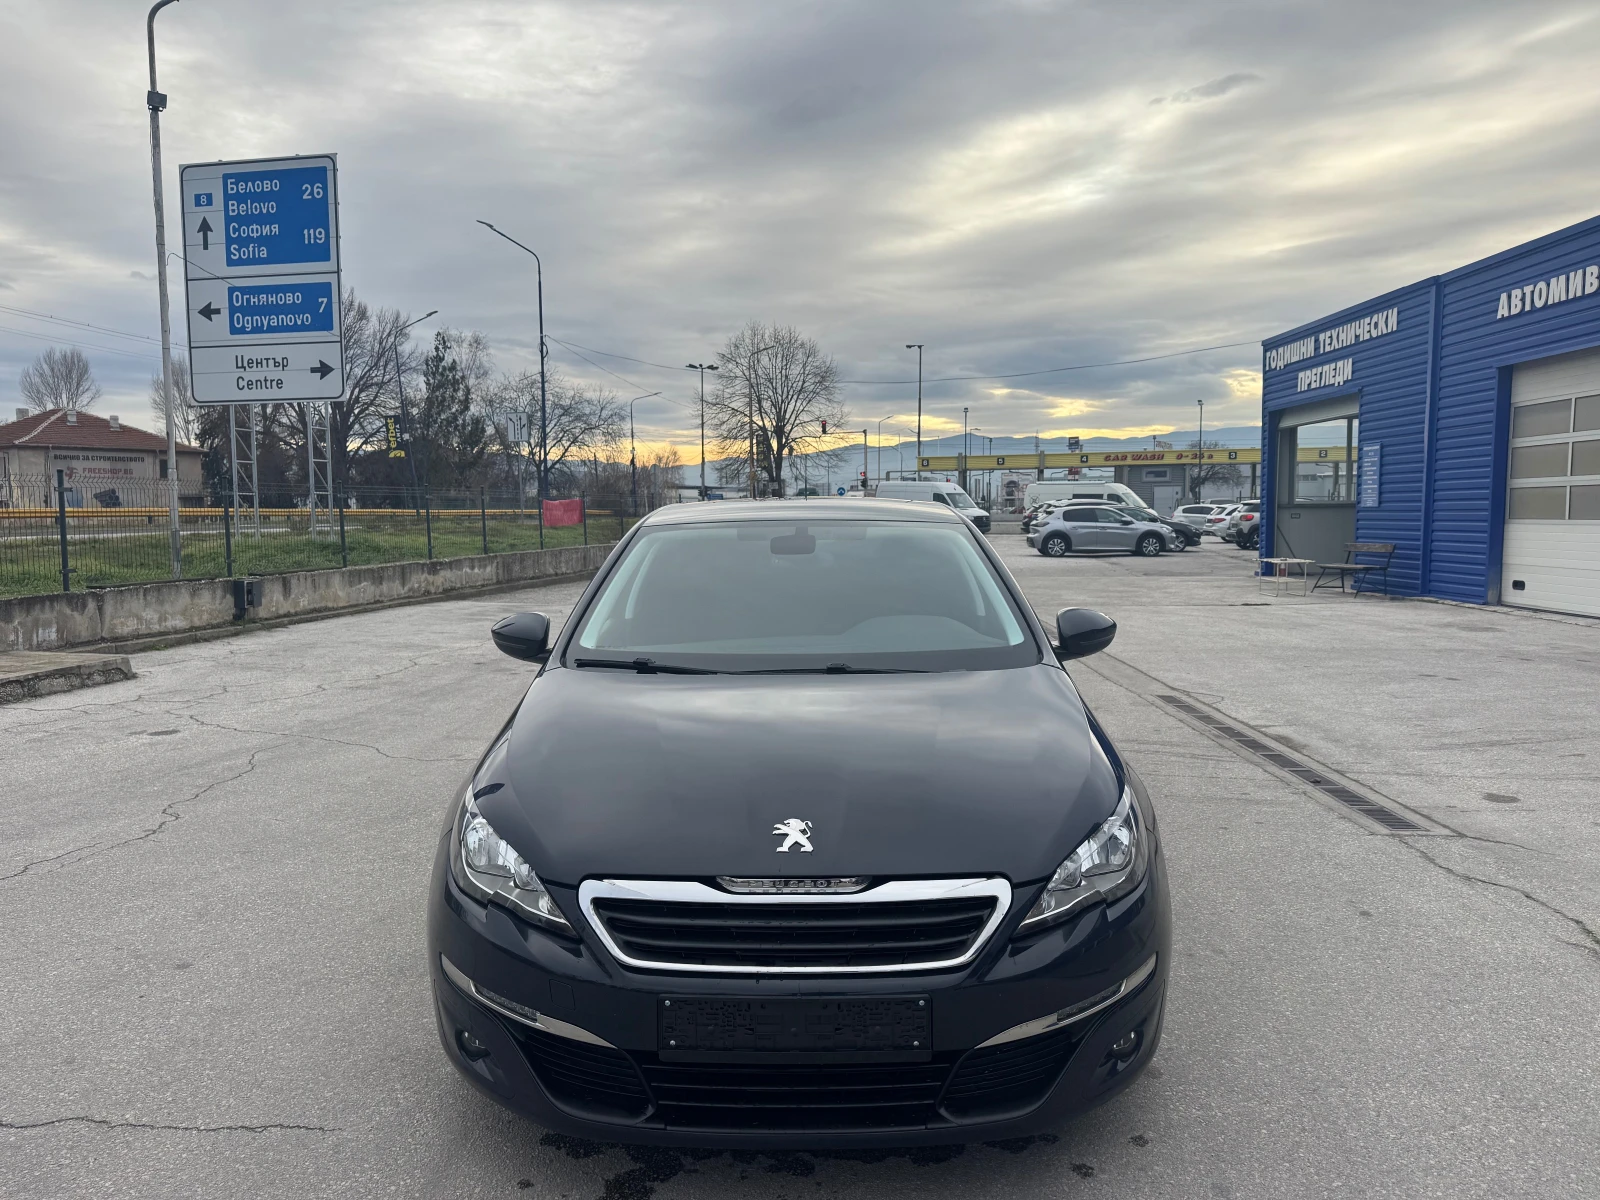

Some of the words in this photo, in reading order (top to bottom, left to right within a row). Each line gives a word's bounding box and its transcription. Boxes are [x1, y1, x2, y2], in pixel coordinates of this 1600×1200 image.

[227, 179, 280, 194] Белово
[302, 183, 323, 199] 26
[200, 195, 207, 205] 8
[228, 200, 277, 216] Belovo
[229, 222, 279, 238] София
[303, 228, 325, 244] 119
[230, 244, 267, 260] Sofia
[232, 291, 302, 306] Огняново
[1497, 265, 1600, 320] АВТОМИВ
[318, 298, 328, 313] 7
[233, 312, 311, 331] Ognyanovo
[1265, 336, 1315, 371] ГОДИШНИ
[1319, 307, 1398, 354] ТЕХНИЧЕСКИ
[235, 354, 289, 371] Център
[236, 376, 284, 391] Centre
[1297, 358, 1353, 393] ПРЕГЛЕДИ
[387, 417, 397, 448] efbet
[81, 454, 90, 462] ЗА
[1104, 454, 1128, 462] CAR
[1132, 453, 1165, 461] WASH
[748, 880, 840, 888] PEUGEOT
